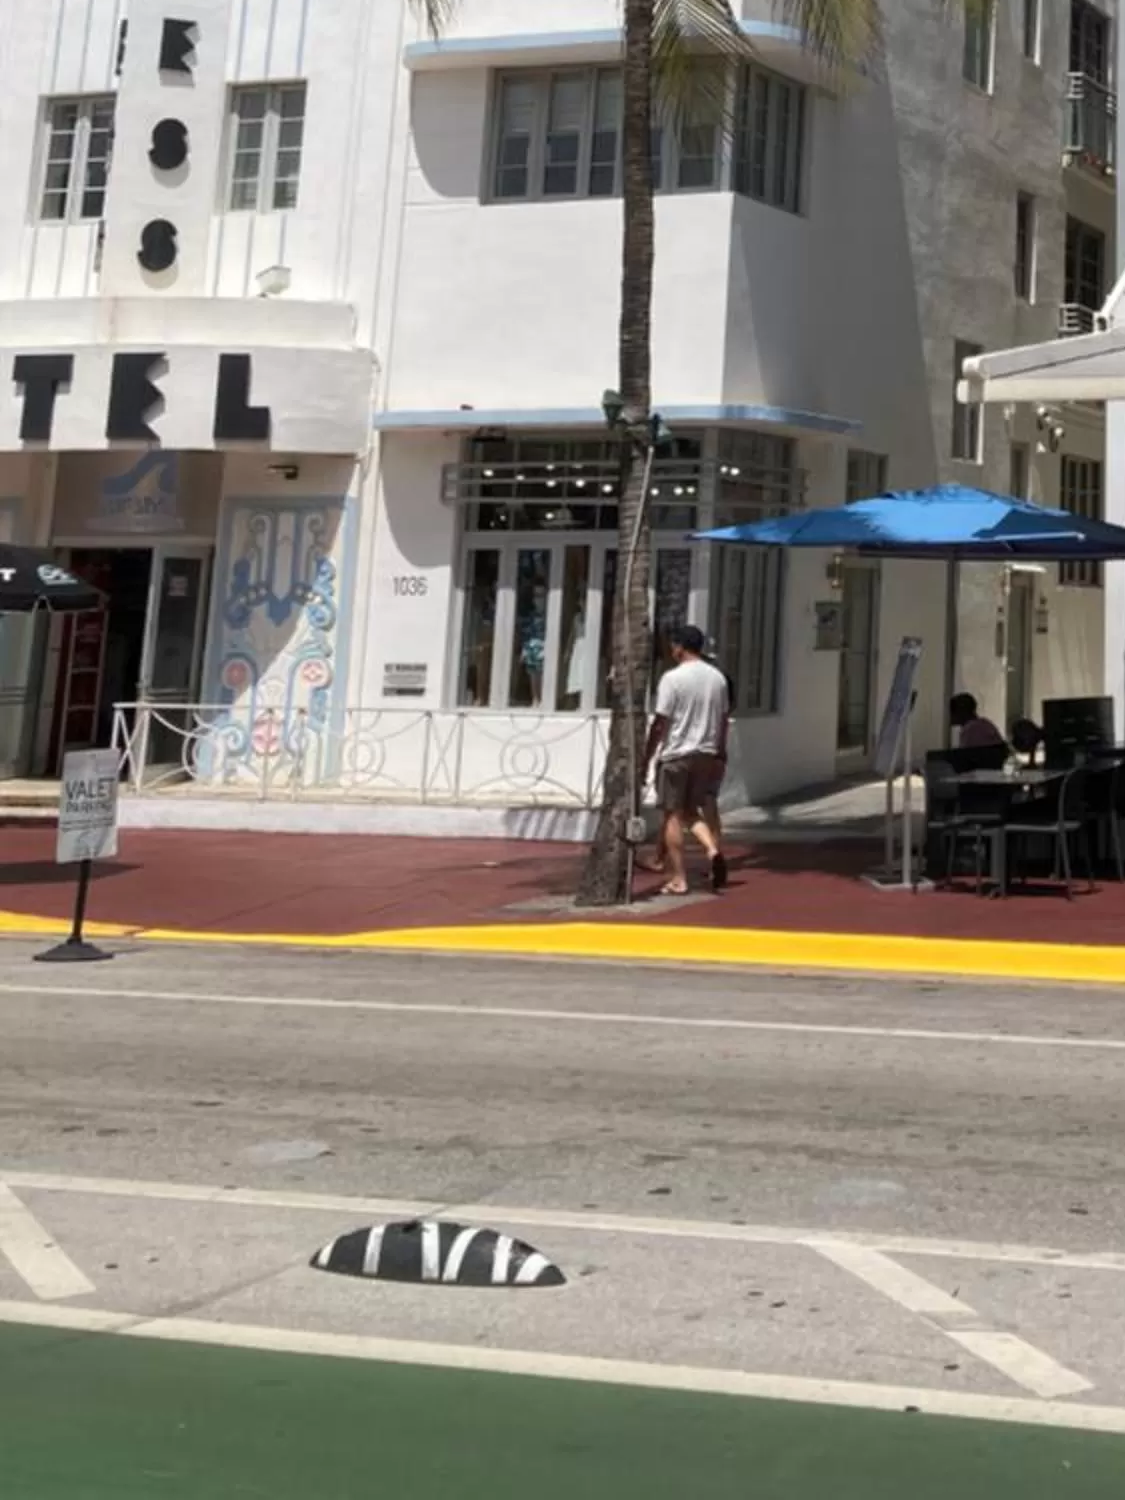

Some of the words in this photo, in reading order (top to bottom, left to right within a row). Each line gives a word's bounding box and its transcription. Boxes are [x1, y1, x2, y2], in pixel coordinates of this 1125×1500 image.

[12, 353, 271, 440] TEL
[393, 576, 429, 596] 1036
[65, 777, 116, 798] VALET
